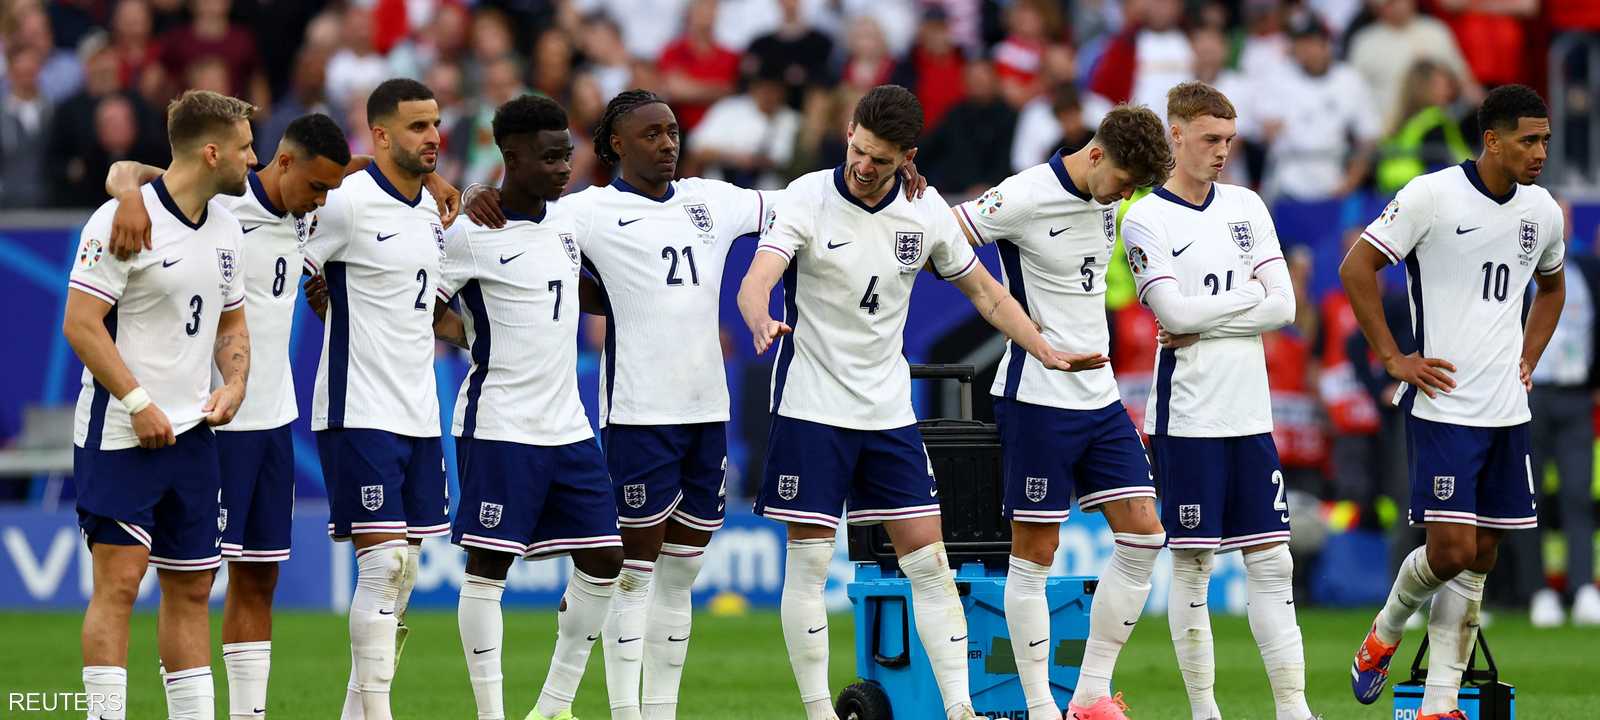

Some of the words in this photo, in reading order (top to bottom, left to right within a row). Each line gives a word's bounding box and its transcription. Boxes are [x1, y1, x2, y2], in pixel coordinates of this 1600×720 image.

[272, 256, 288, 298] 8
[661, 245, 699, 286] 21
[1080, 256, 1096, 293] 5
[1481, 261, 1511, 302] 10
[414, 268, 429, 312] 2
[547, 279, 563, 321] 7
[859, 275, 881, 316] 4
[185, 294, 204, 337] 3
[1271, 469, 1288, 511] 2
